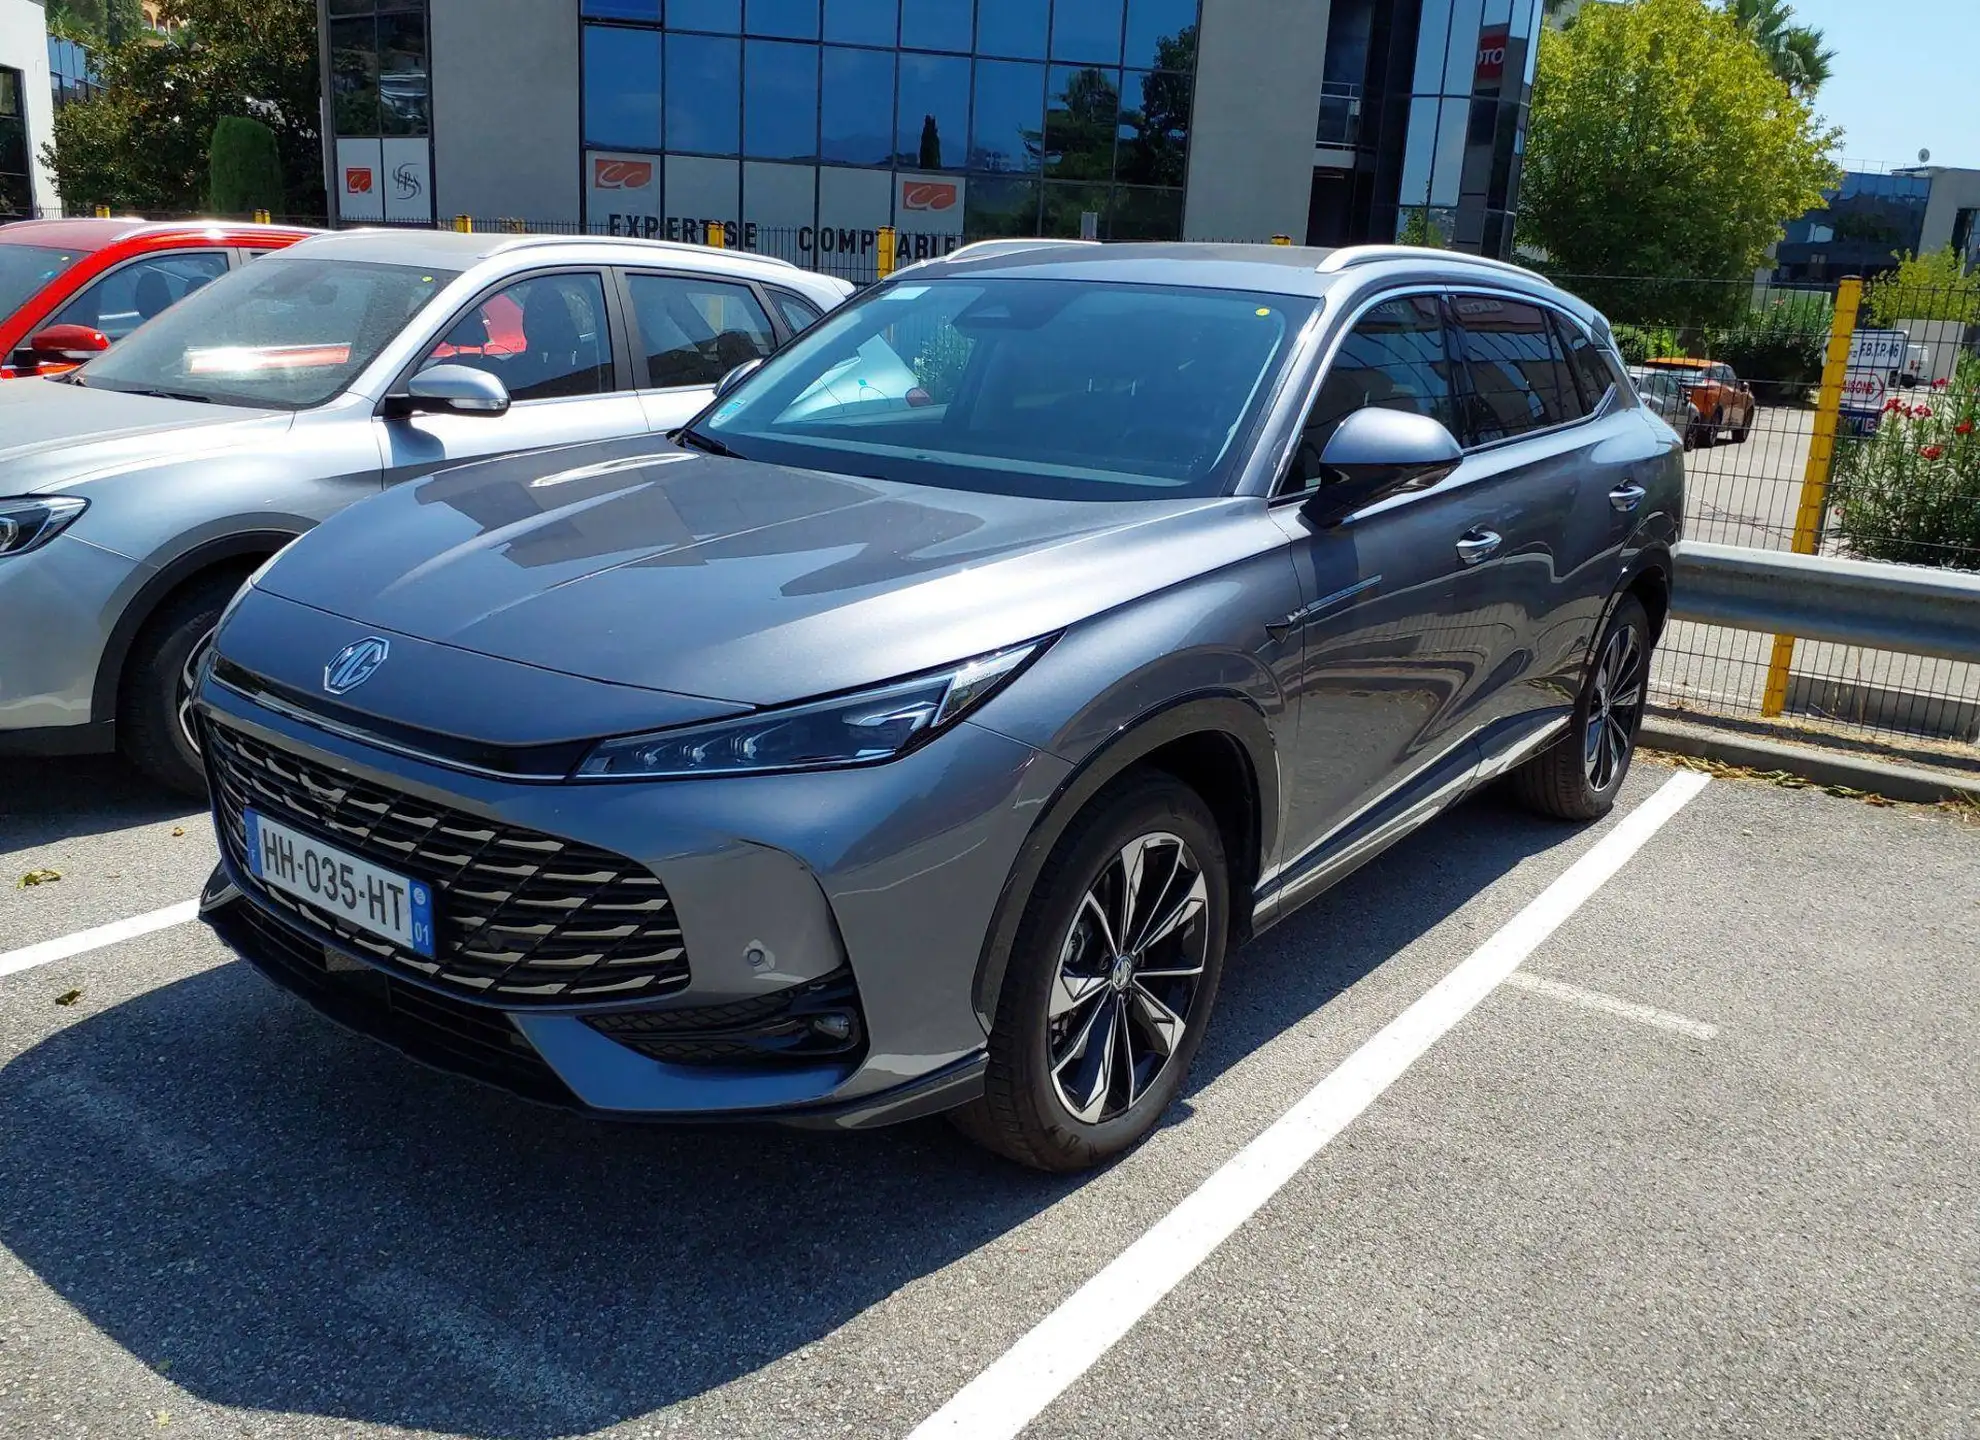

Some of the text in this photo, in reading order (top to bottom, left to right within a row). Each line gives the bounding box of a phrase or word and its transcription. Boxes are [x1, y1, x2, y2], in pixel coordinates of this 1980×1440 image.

[608, 214, 956, 259] EXPERTSE COMPABLE
[327, 639, 385, 690] MG
[262, 828, 404, 931] HH-035-HT
[414, 921, 429, 946] 01
